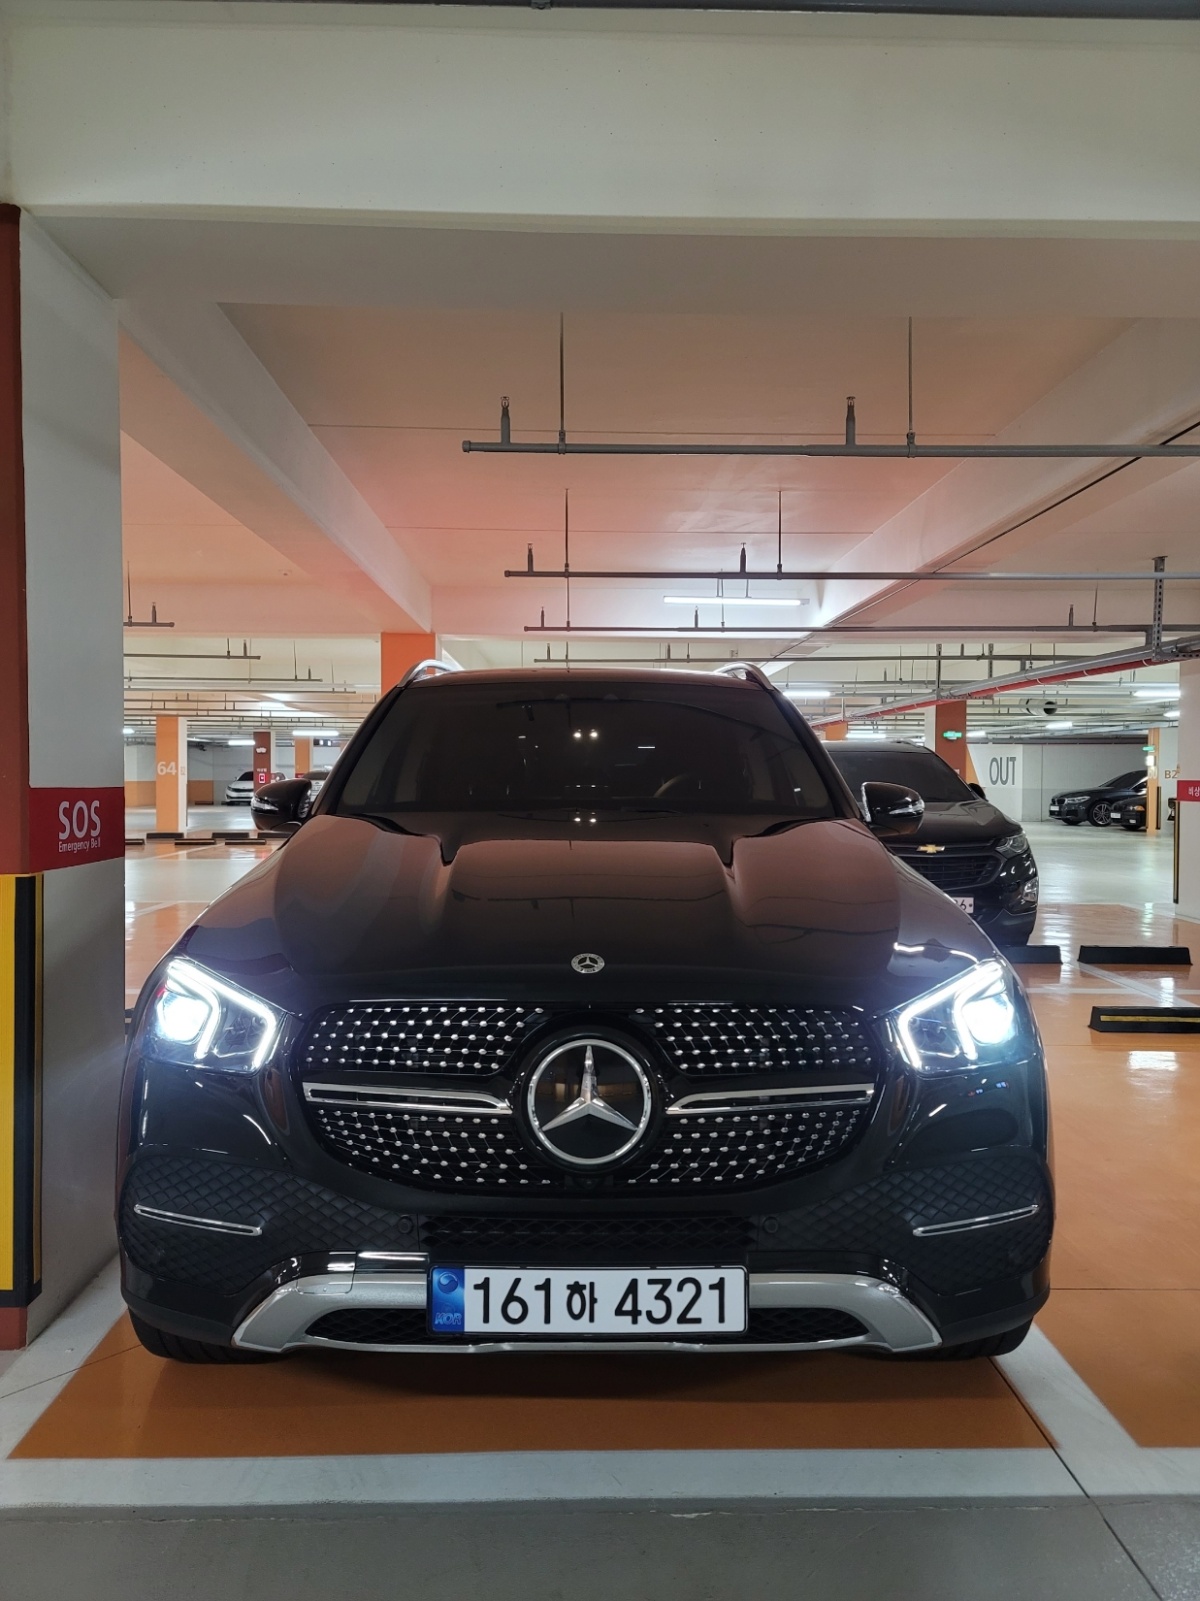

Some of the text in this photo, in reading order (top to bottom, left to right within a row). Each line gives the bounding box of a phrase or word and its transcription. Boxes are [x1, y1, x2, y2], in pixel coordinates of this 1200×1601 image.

[157, 761, 177, 776] 64
[989, 756, 1017, 786] OUT
[58, 800, 101, 840] SOS
[58, 840, 90, 854] Emergency
[473, 1277, 725, 1325] 161하 4321
[434, 1312, 462, 1325] KOR
